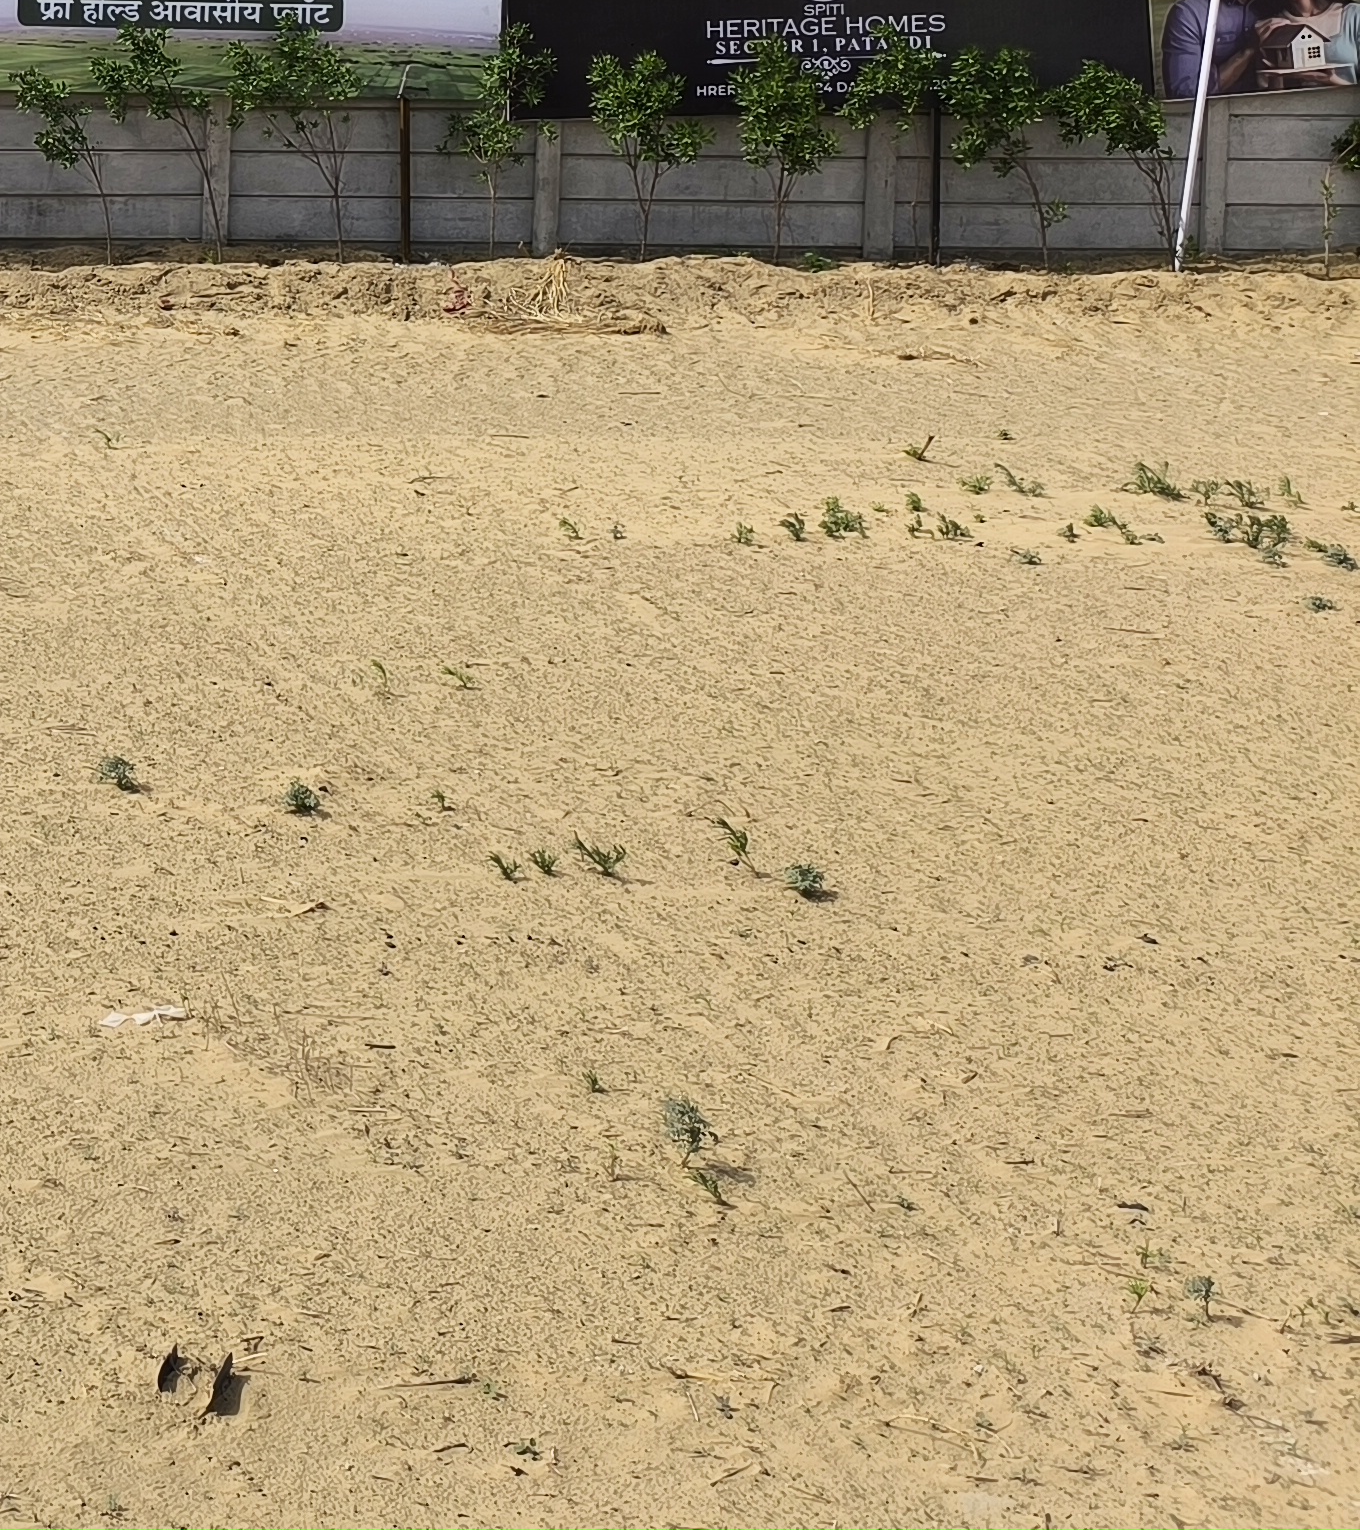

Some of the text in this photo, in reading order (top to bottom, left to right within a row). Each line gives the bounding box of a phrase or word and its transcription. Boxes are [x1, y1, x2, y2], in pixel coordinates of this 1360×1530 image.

[803, 3, 845, 16] SPITI
[706, 14, 946, 39] HERITAGE HOMES
[715, 39, 804, 55] SECR
[835, 35, 931, 52] PATADI
